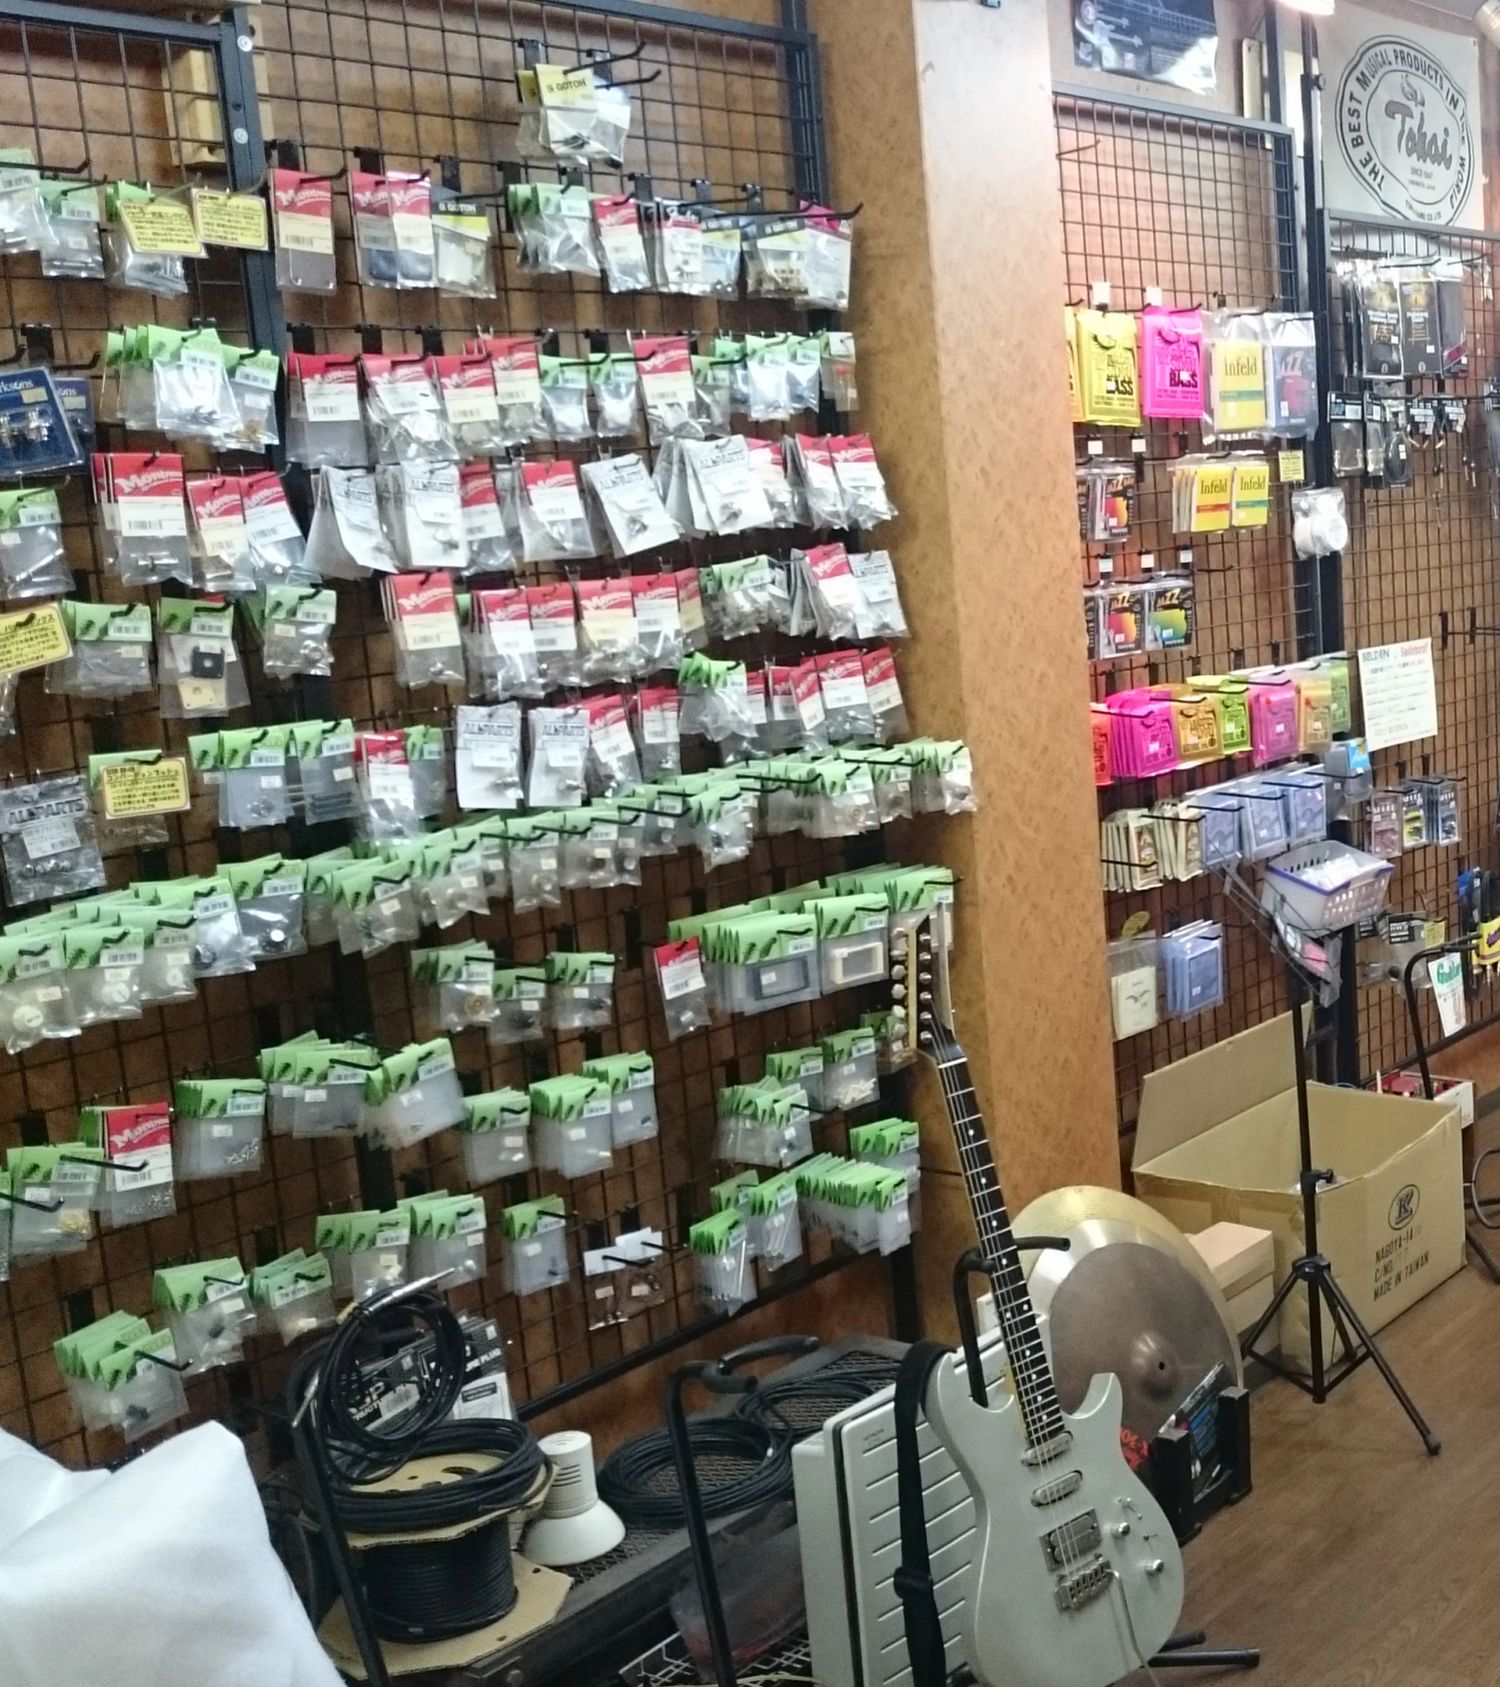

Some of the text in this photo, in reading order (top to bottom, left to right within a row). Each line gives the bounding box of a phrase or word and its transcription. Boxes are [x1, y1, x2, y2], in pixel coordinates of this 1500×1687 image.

[1355, 48, 1393, 91] MUSICAL
[1393, 49, 1444, 90] PRODUCTS
[556, 77, 587, 92] GOTOH
[1444, 86, 1459, 110] IN
[1347, 90, 1365, 149] BEST
[1384, 99, 1453, 171] Tokai
[1358, 150, 1386, 192] THE
[1200, 478, 1227, 495] Infeld
[1240, 476, 1266, 492] Infeld
[7, 796, 86, 825] ALLPARTS
[1403, 1251, 1430, 1277] TAIWAN
